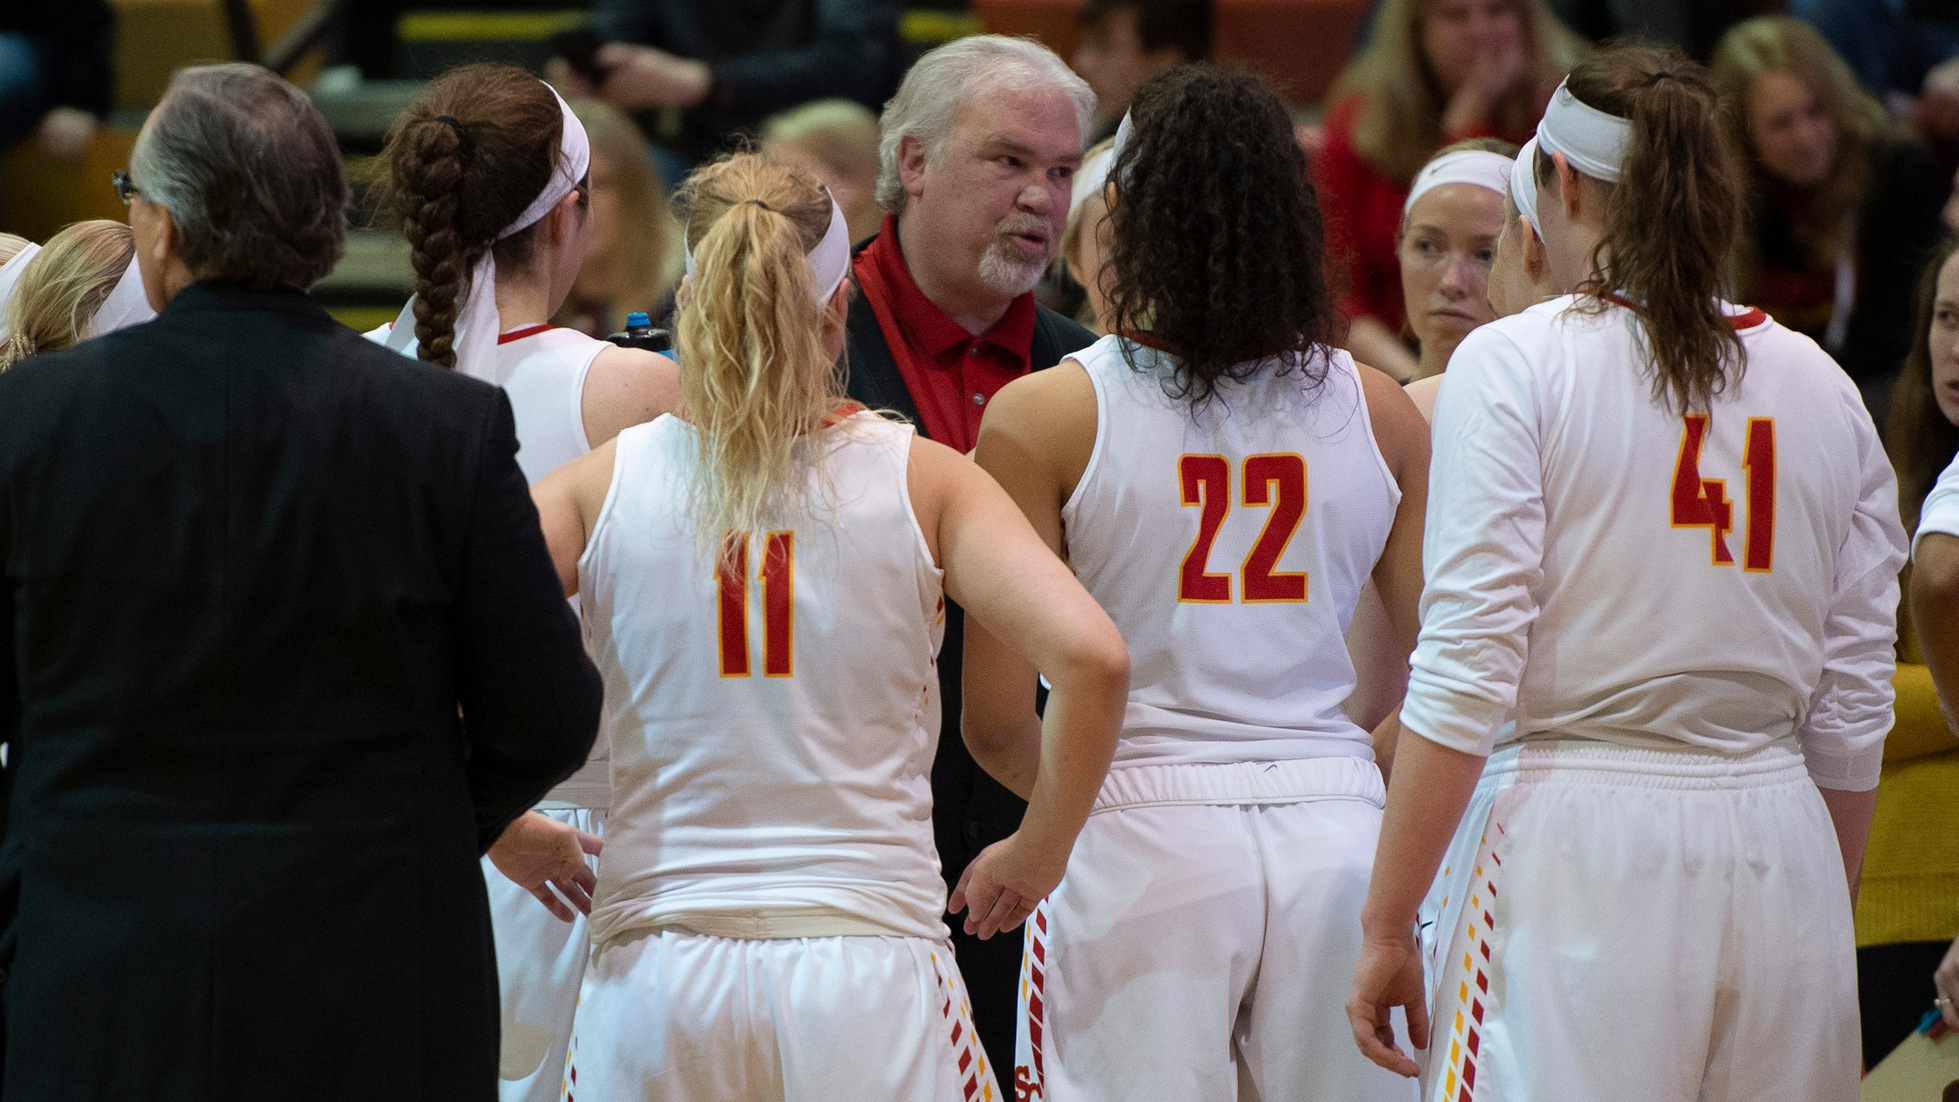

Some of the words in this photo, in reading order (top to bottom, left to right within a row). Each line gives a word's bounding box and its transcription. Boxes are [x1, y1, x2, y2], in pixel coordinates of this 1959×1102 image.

[1177, 452, 1309, 604] 22
[1669, 413, 1777, 573] 41
[713, 529, 794, 678] 11
